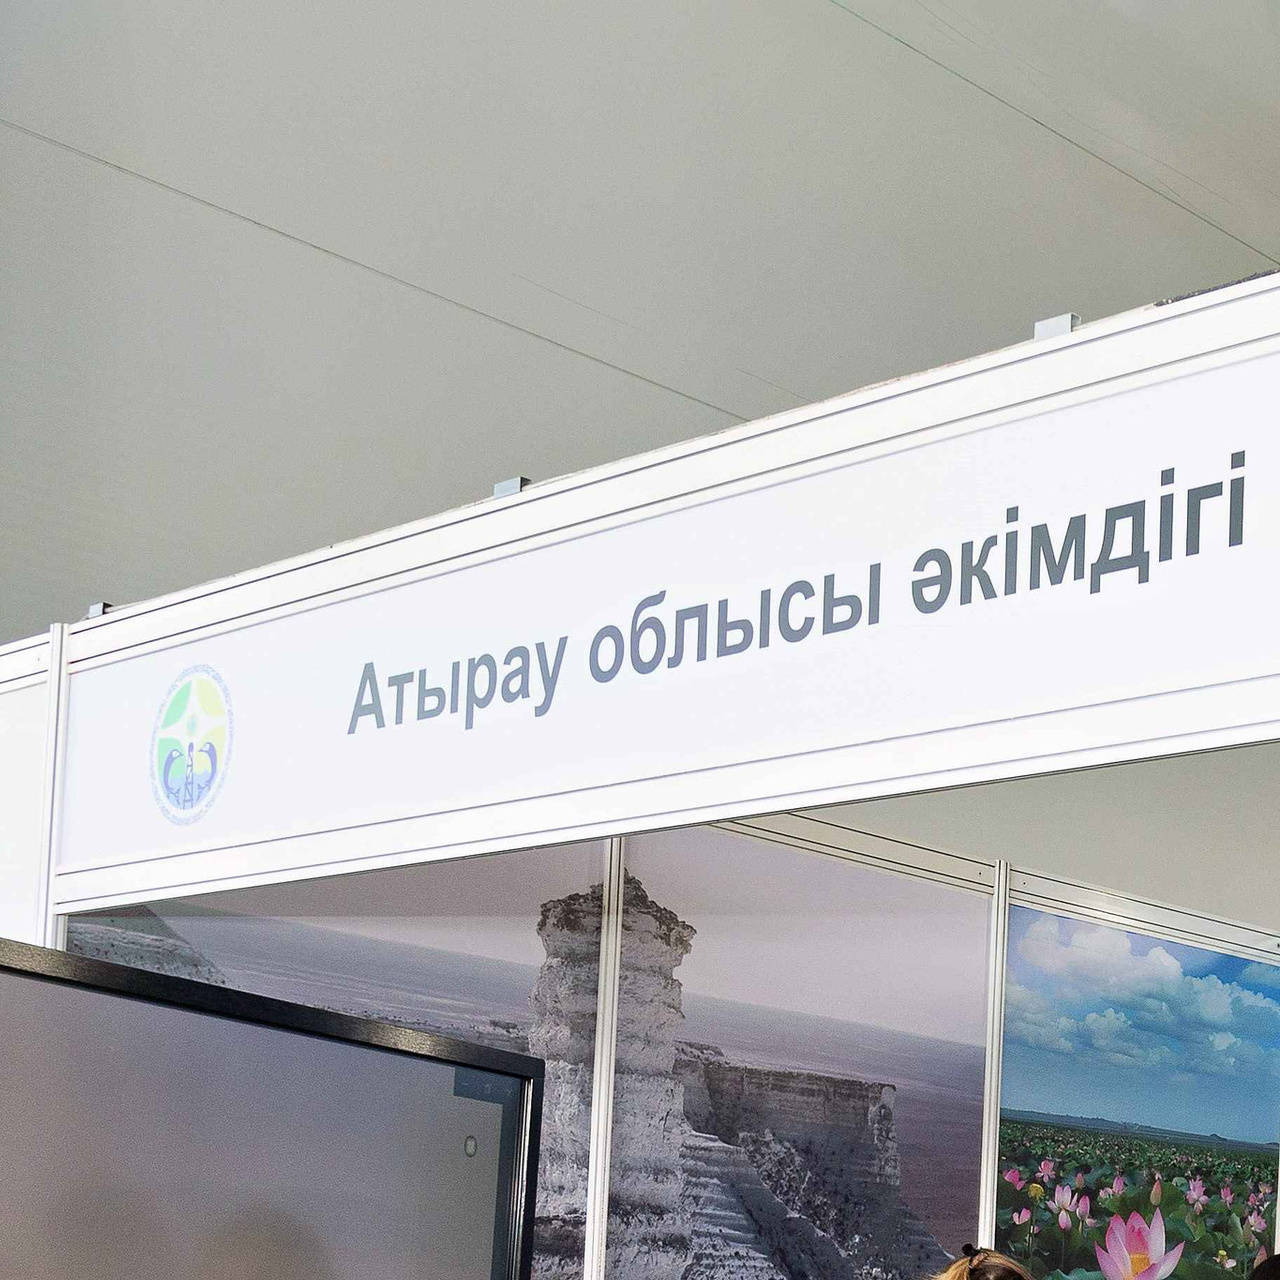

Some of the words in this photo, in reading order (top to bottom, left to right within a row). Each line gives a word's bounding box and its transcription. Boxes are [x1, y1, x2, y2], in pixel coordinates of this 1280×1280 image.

[347, 637, 568, 735] Атырау
[588, 563, 882, 684] облысы
[911, 450, 1246, 613] әкімдігі
